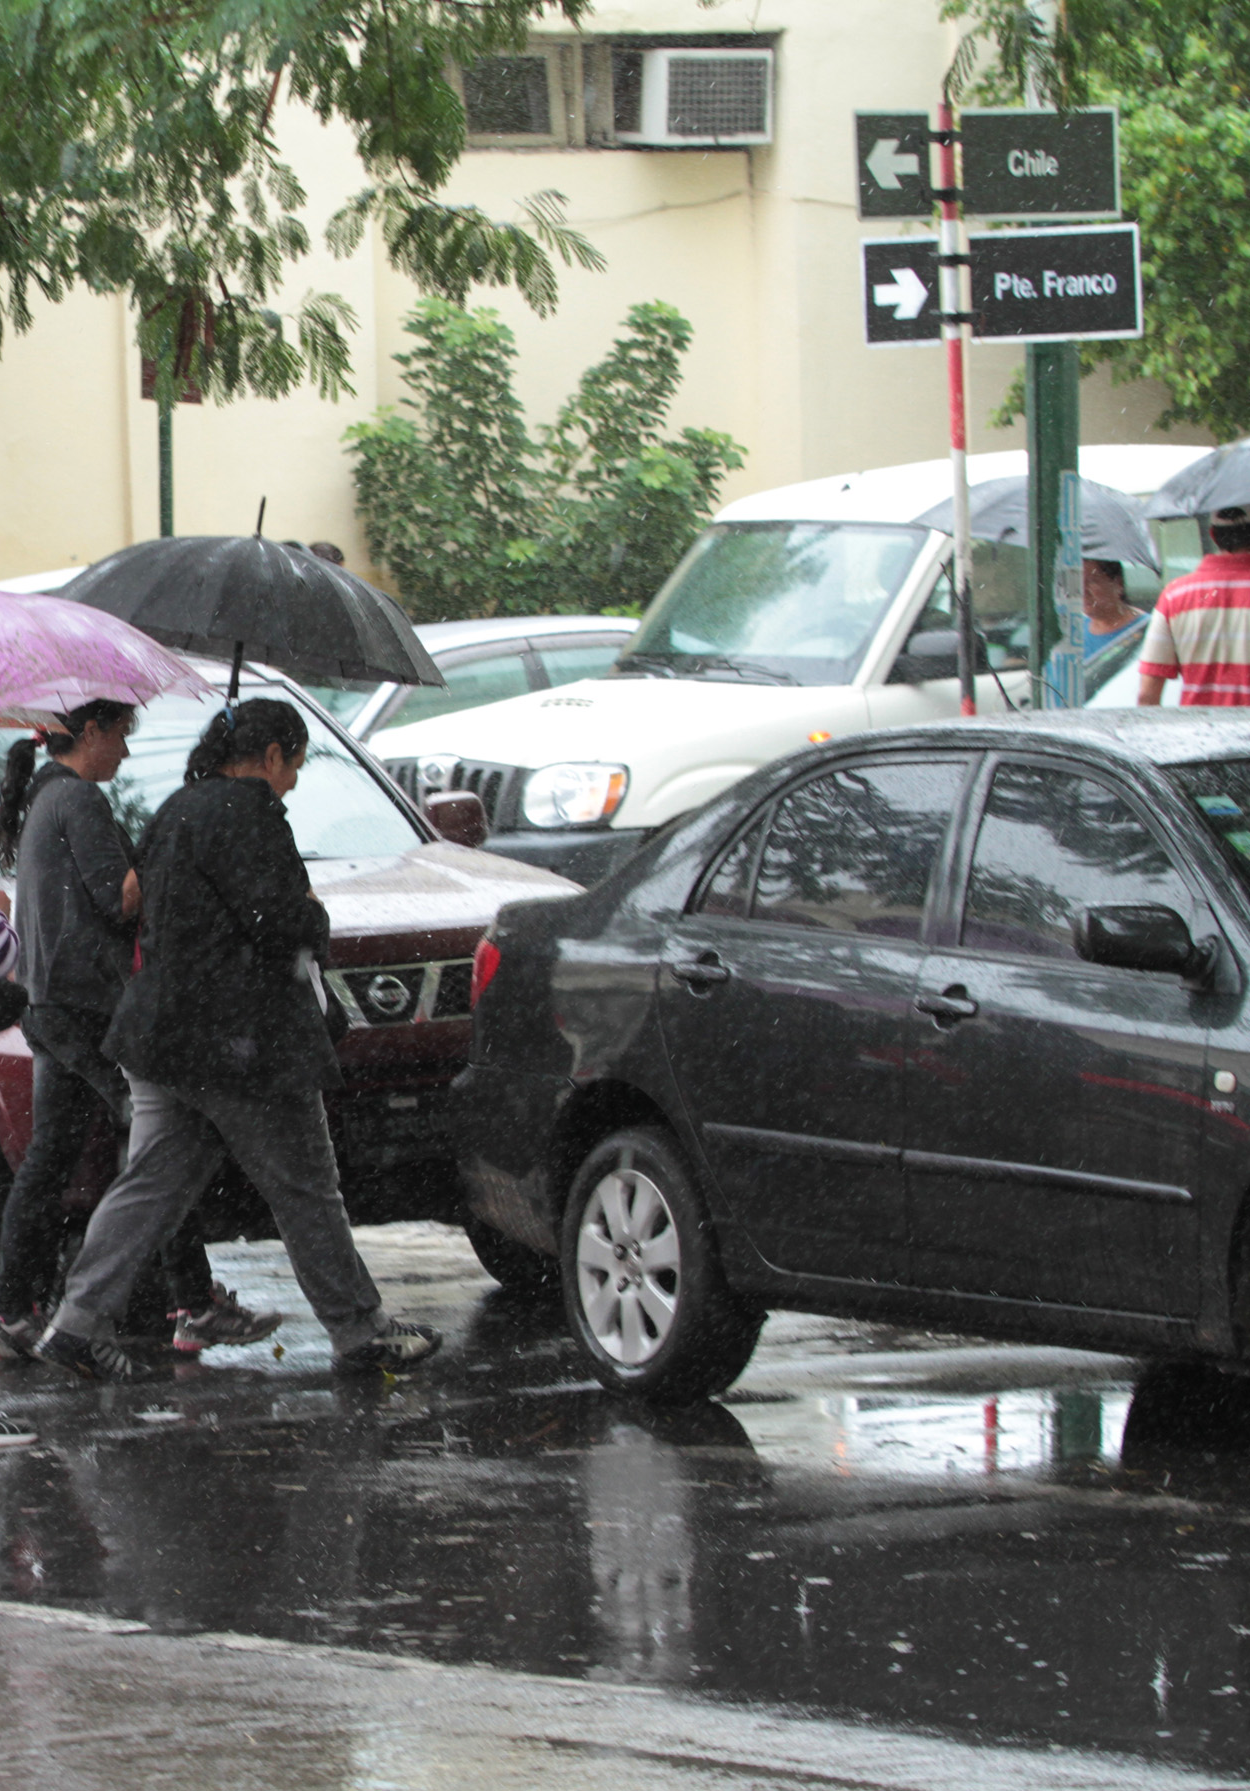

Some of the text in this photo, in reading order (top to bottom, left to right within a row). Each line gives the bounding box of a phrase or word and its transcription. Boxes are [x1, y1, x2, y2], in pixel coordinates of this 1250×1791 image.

[1007, 149, 1060, 178] Chile
[994, 270, 1118, 301] Pte. Franco
